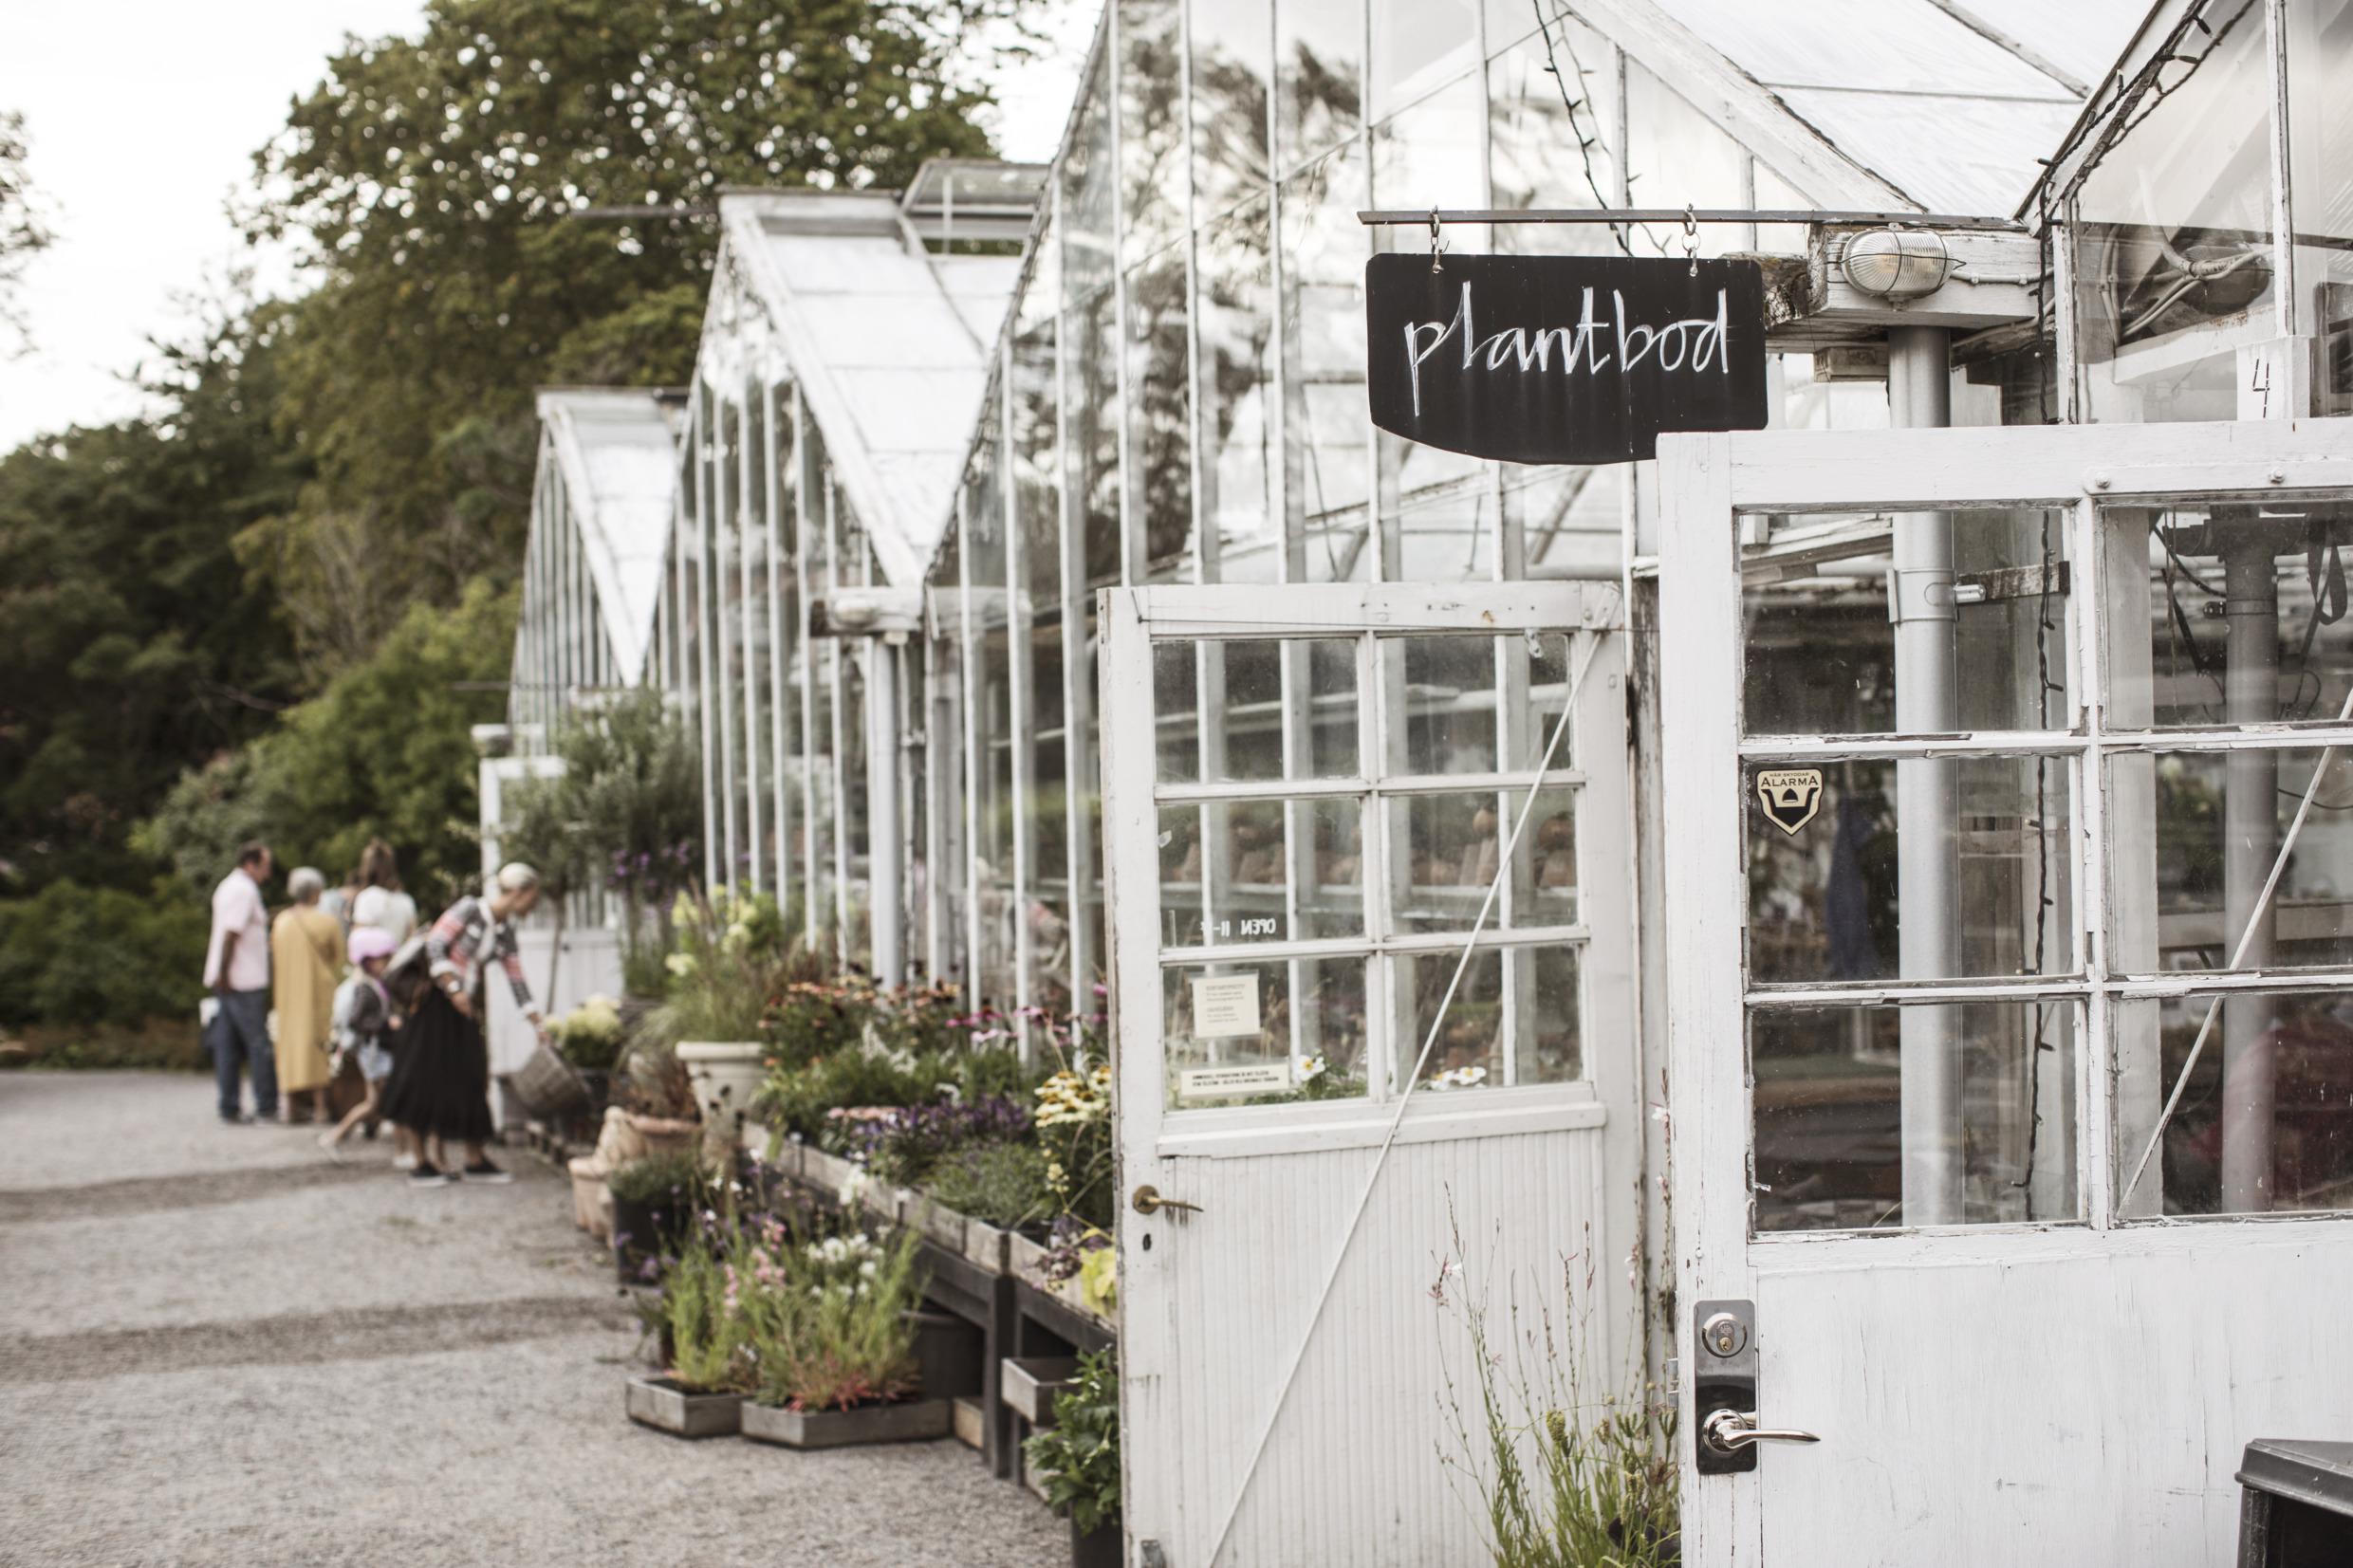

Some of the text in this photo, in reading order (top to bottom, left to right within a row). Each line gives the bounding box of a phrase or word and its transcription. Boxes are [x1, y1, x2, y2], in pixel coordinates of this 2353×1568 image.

[1404, 281, 1730, 416] plantbod
[2252, 358, 2270, 418] 4
[1760, 775, 1819, 787] ALARMA
